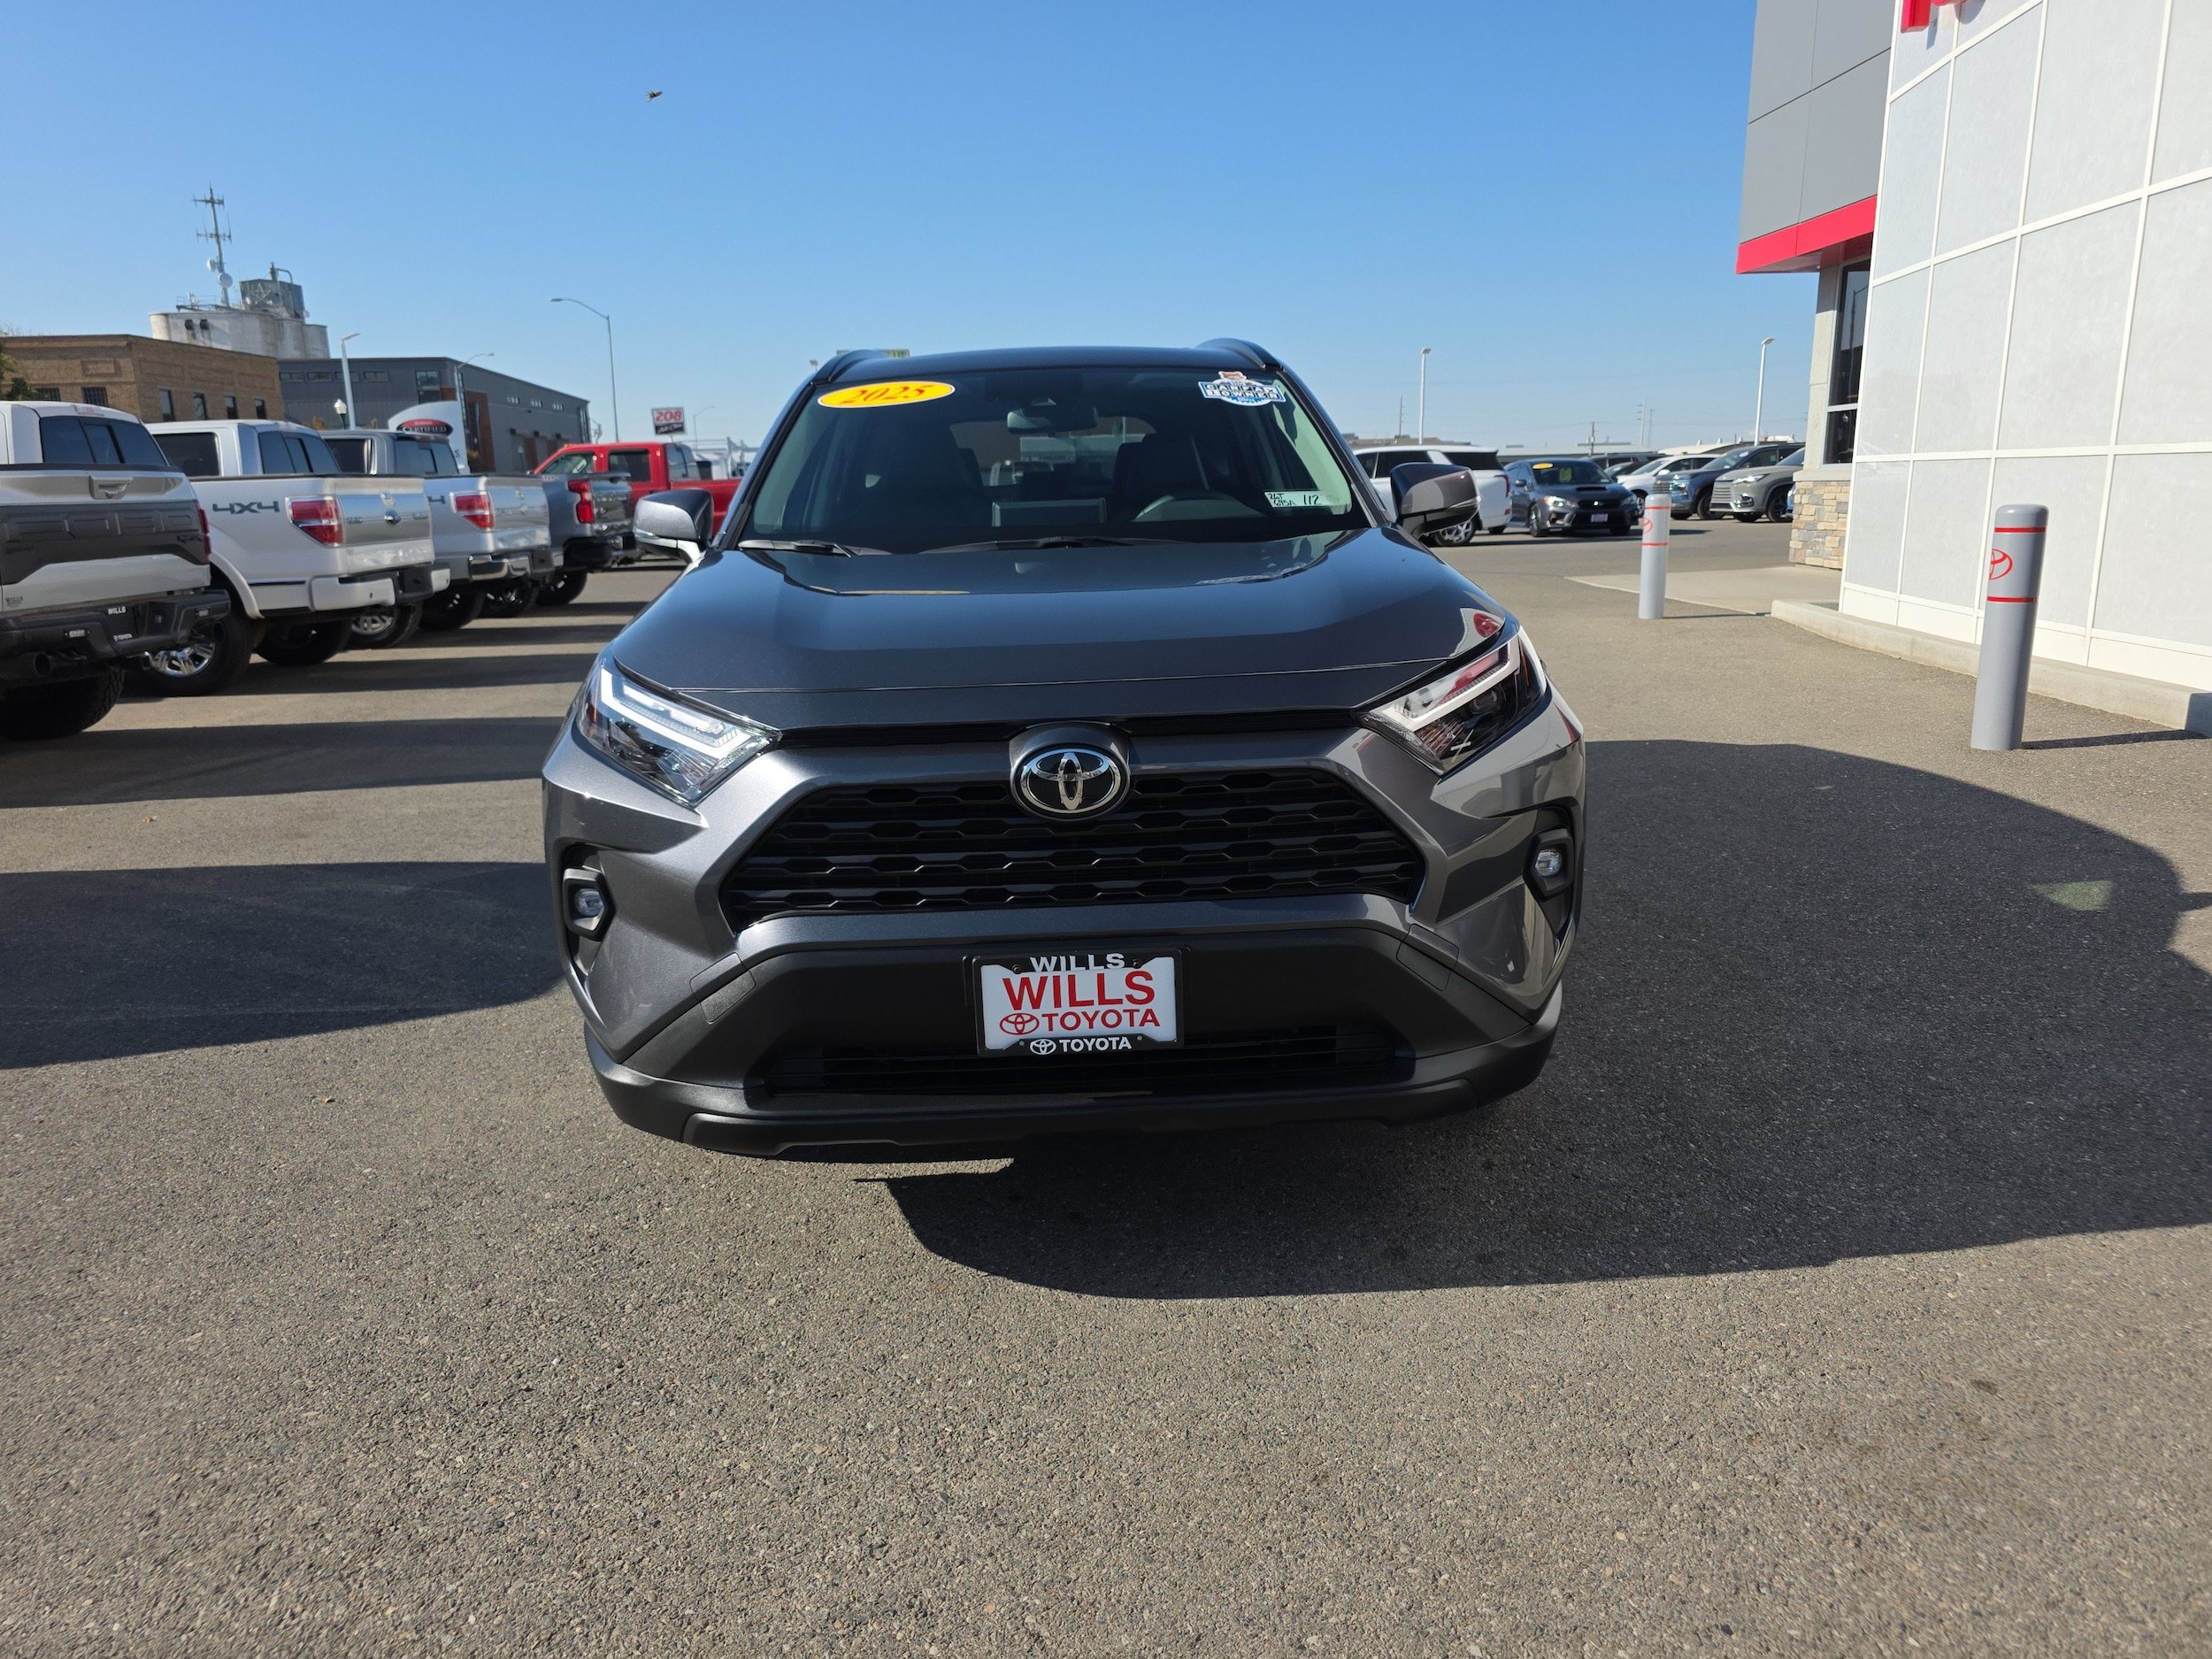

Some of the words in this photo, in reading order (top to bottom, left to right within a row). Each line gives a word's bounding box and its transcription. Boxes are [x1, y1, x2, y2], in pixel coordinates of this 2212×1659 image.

[839, 384, 934, 405] 2025
[1205, 383, 1276, 394] CARFAX
[656, 410, 681, 423] 208
[1302, 494, 1323, 505] 112
[4, 595, 24, 603] WILLS
[107, 605, 127, 615] WILLS
[1029, 952, 1125, 973] WILLS
[1002, 970, 1156, 1011] WILLS
[1041, 1007, 1162, 1033] TOYOTA
[1058, 1035, 1133, 1054] TOYOTA
